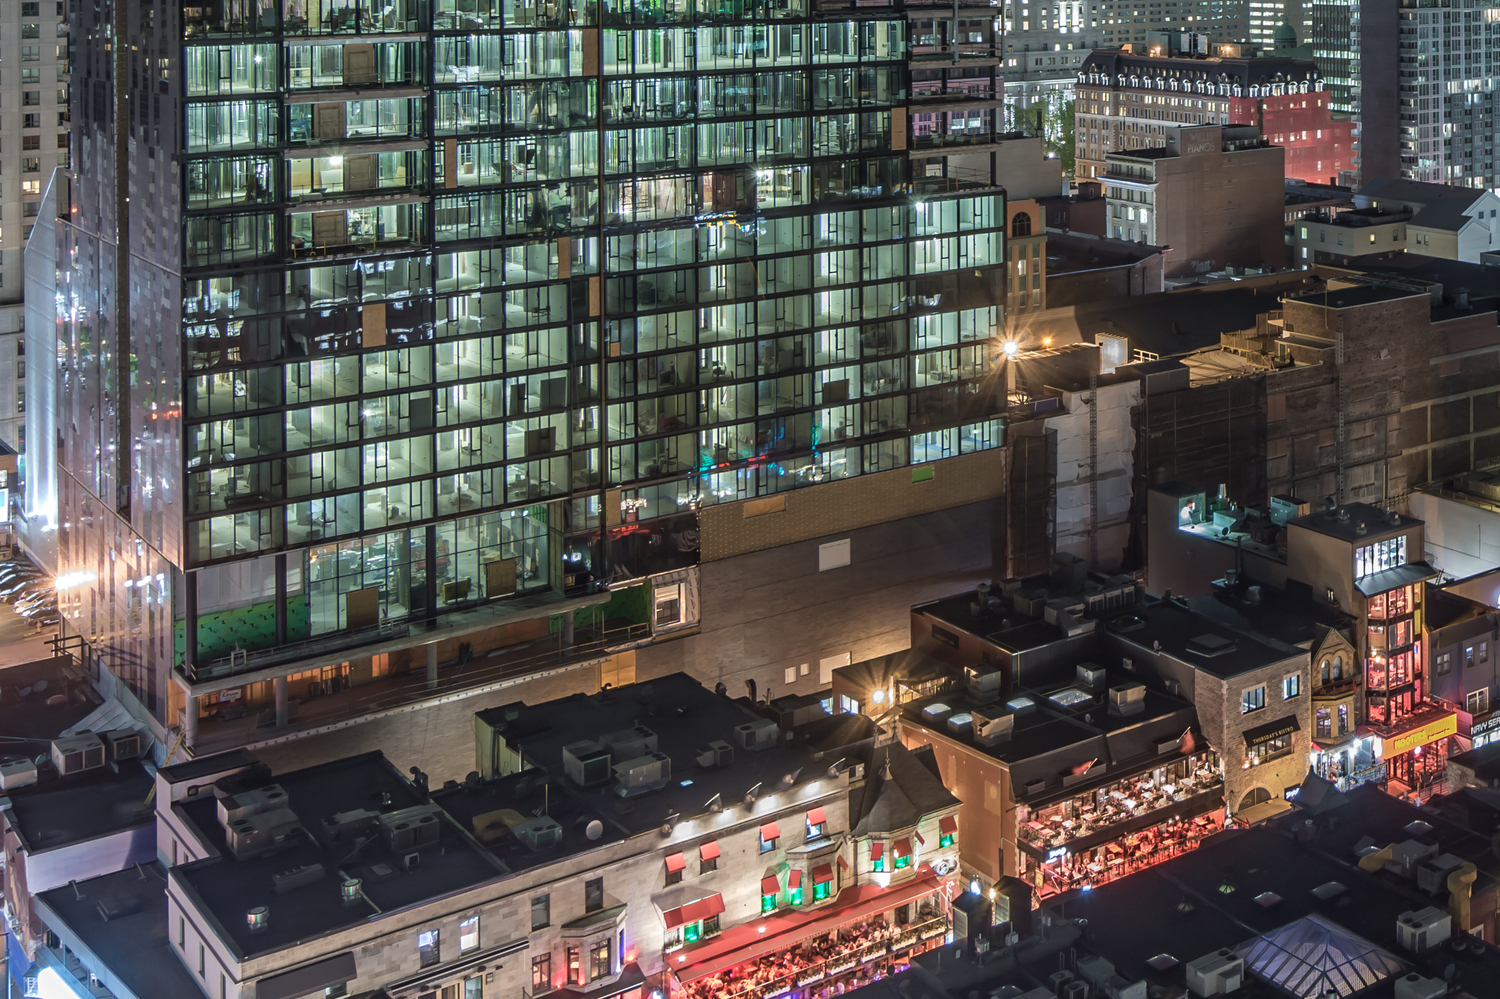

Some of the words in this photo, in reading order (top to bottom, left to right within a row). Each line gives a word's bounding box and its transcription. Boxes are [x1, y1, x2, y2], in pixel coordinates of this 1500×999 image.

[1189, 132, 1214, 142] WILLIS
[1187, 142, 1216, 154] PIANOS
[1278, 725, 1294, 736] BISTRO
[1470, 720, 1488, 736] NAVY
